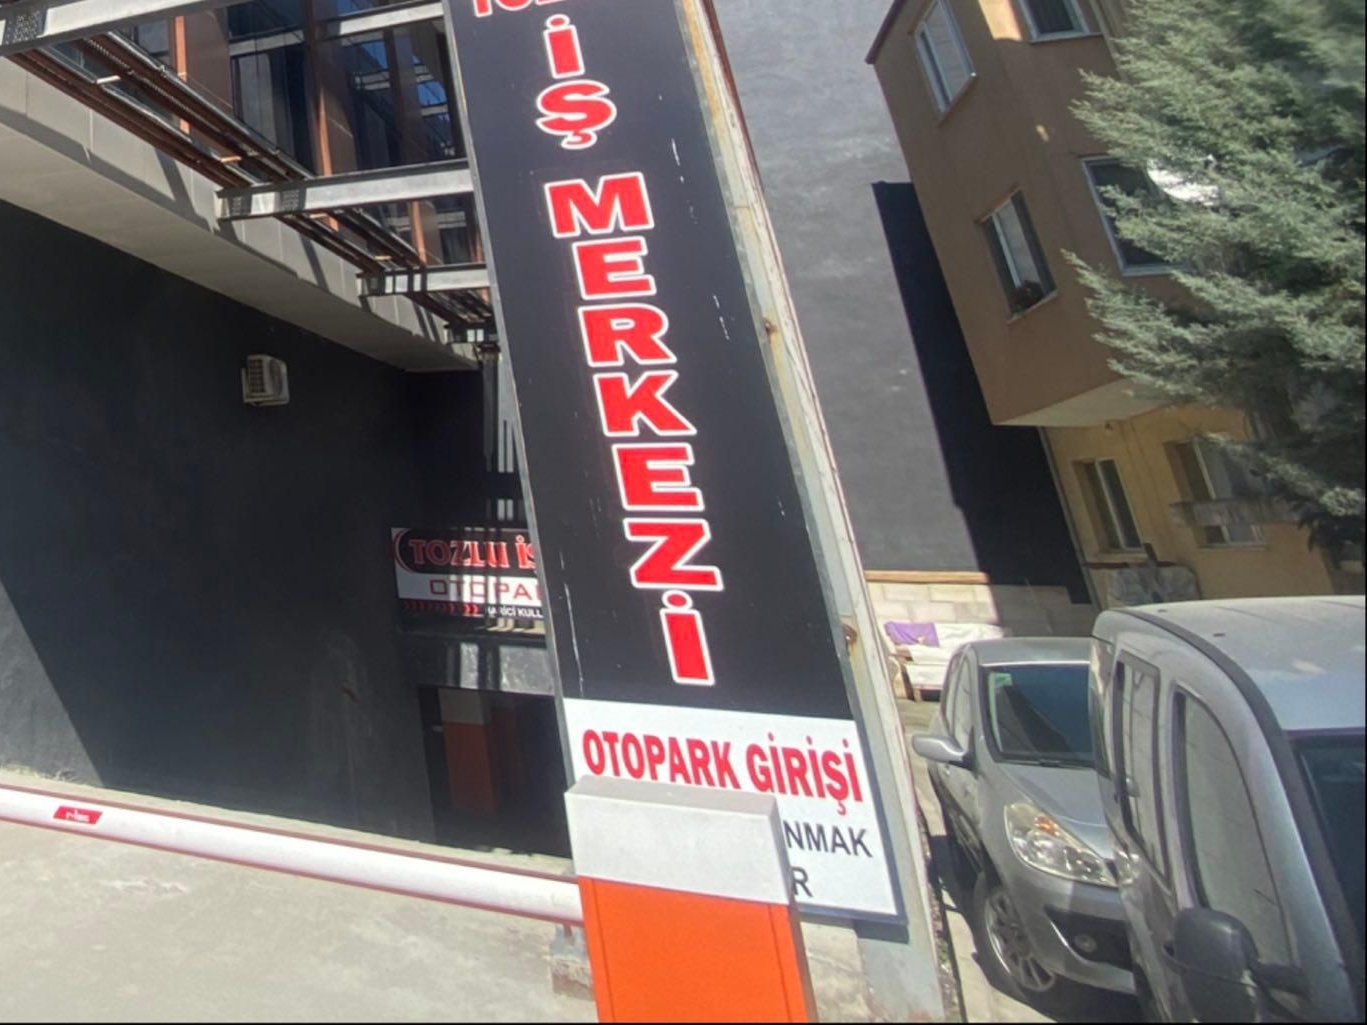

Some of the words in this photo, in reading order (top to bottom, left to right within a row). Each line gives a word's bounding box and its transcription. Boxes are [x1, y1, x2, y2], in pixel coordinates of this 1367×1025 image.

[536, 14, 617, 150] İŞ
[545, 172, 724, 686] MERKEZİ
[409, 539, 510, 568] TOZLU
[429, 579, 543, 603] OTOPA
[583, 729, 741, 789] OTOPARK
[745, 732, 863, 816] GİRİŞİ
